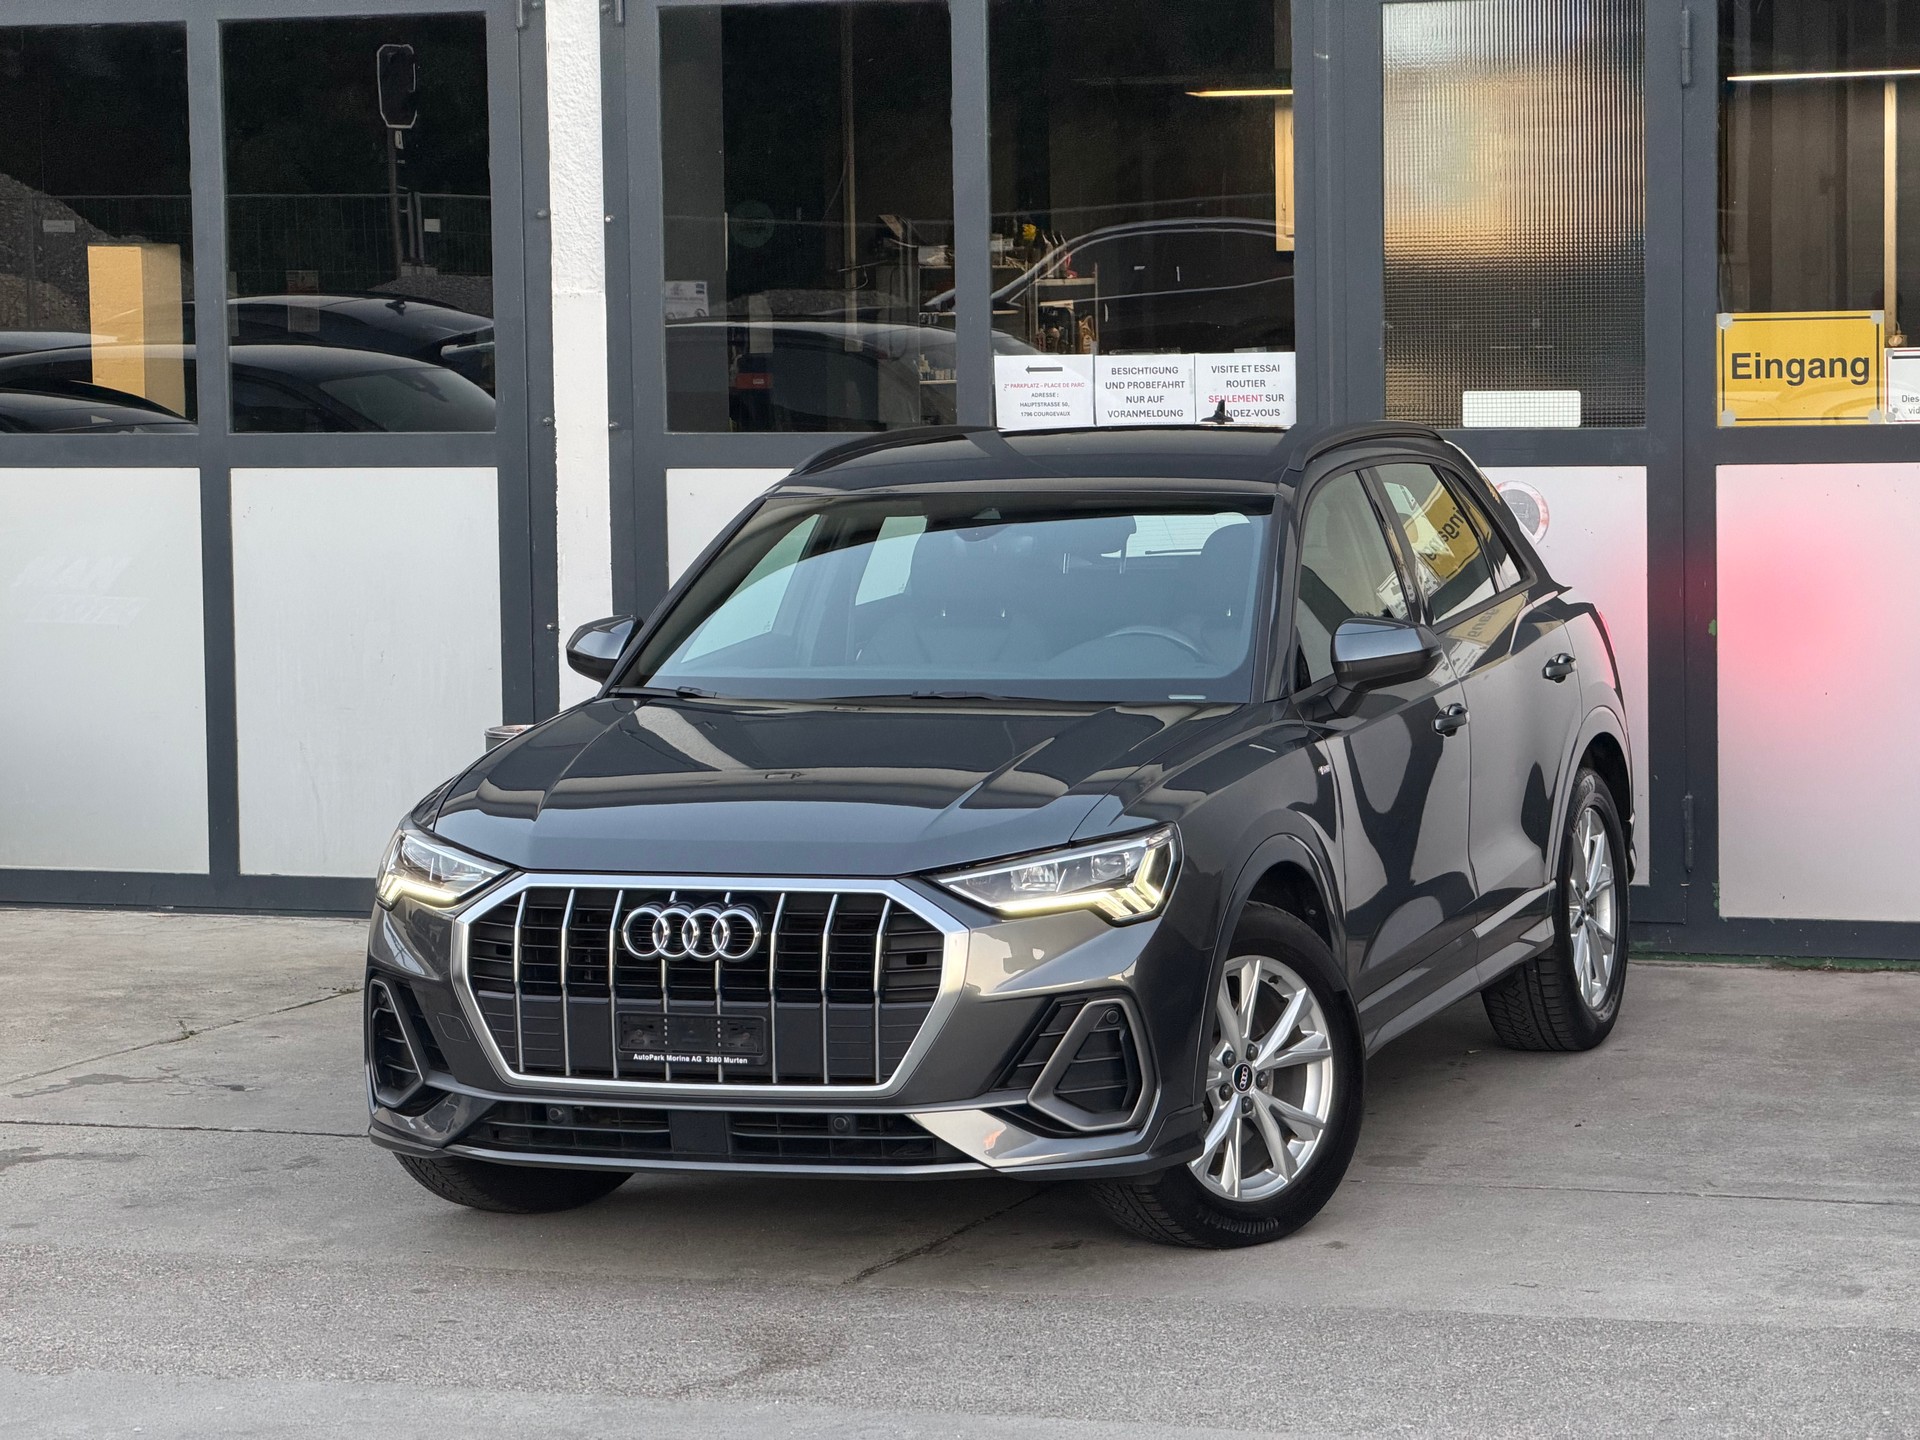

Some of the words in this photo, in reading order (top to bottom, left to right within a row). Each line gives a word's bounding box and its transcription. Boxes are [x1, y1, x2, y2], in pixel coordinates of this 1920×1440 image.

[1111, 366, 1179, 375] BESICHTIGUNG
[1211, 365, 1239, 374] VISITE
[1241, 365, 1252, 373] ET
[1254, 364, 1280, 373] ESSAI
[1731, 352, 1870, 387] Eingang
[1105, 381, 1125, 390] UND
[1127, 380, 1185, 389] PROBEFAHRT
[1226, 379, 1266, 388] ROUTIER
[1126, 395, 1145, 403] NUR
[1147, 395, 1164, 403] AUF
[1208, 394, 1263, 403] SEULEMENT
[1265, 393, 1285, 402] SUR
[1107, 409, 1184, 418] VORANMELDUNG
[1213, 408, 1281, 418] NDEZ-VOUS
[633, 1053, 665, 1061] AutoPark
[723, 1056, 748, 1064] Murten
